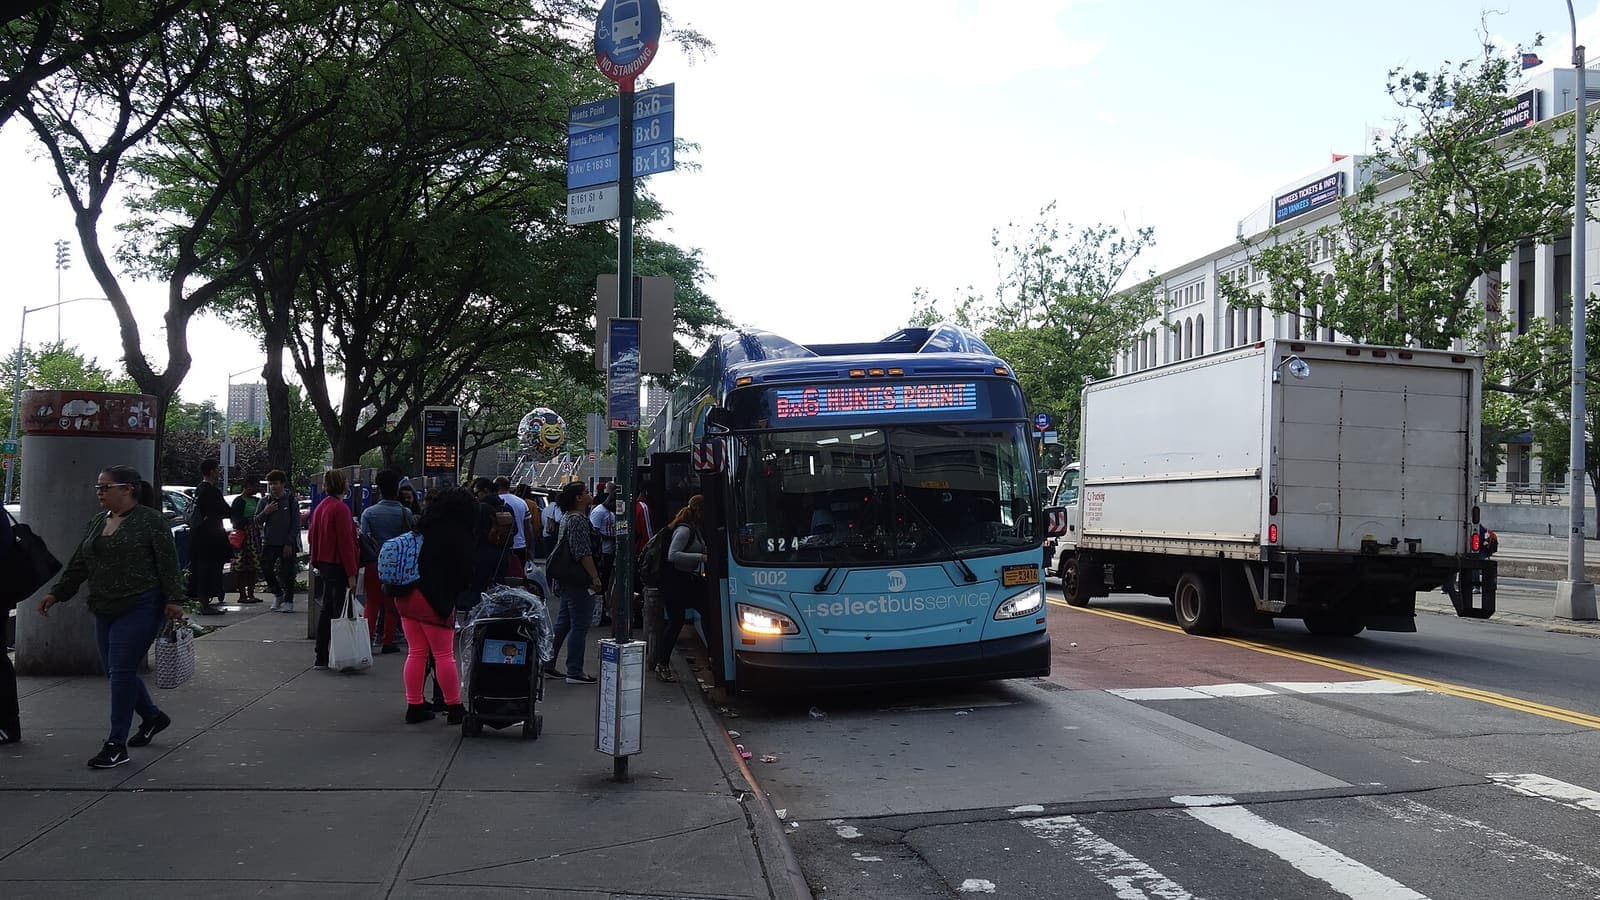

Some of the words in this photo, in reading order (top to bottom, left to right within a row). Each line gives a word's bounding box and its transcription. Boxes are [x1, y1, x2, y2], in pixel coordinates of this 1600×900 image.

[600, 56, 611, 72] NO
[613, 47, 652, 76] STANDING
[571, 109, 588, 121] Hunts
[589, 105, 605, 117] Point
[636, 96, 660, 118] Bx6
[1518, 100, 1530, 111] FOR
[570, 134, 587, 147] Hunts
[588, 131, 604, 144] Point
[636, 119, 660, 143] Bx6
[635, 146, 670, 173] Bx13
[577, 194, 587, 204] 161
[588, 192, 595, 202] St
[1278, 192, 1298, 207] YANKEES
[1299, 184, 1318, 199] TICKETS
[1323, 177, 1337, 188] INFO
[570, 206, 586, 216] River
[587, 205, 595, 214] Av
[1288, 199, 1310, 213] YANKEES
[776, 386, 820, 418] Bx6
[827, 386, 896, 411] HUNTS
[903, 384, 966, 408] POINT
[752, 571, 787, 585] 1002
